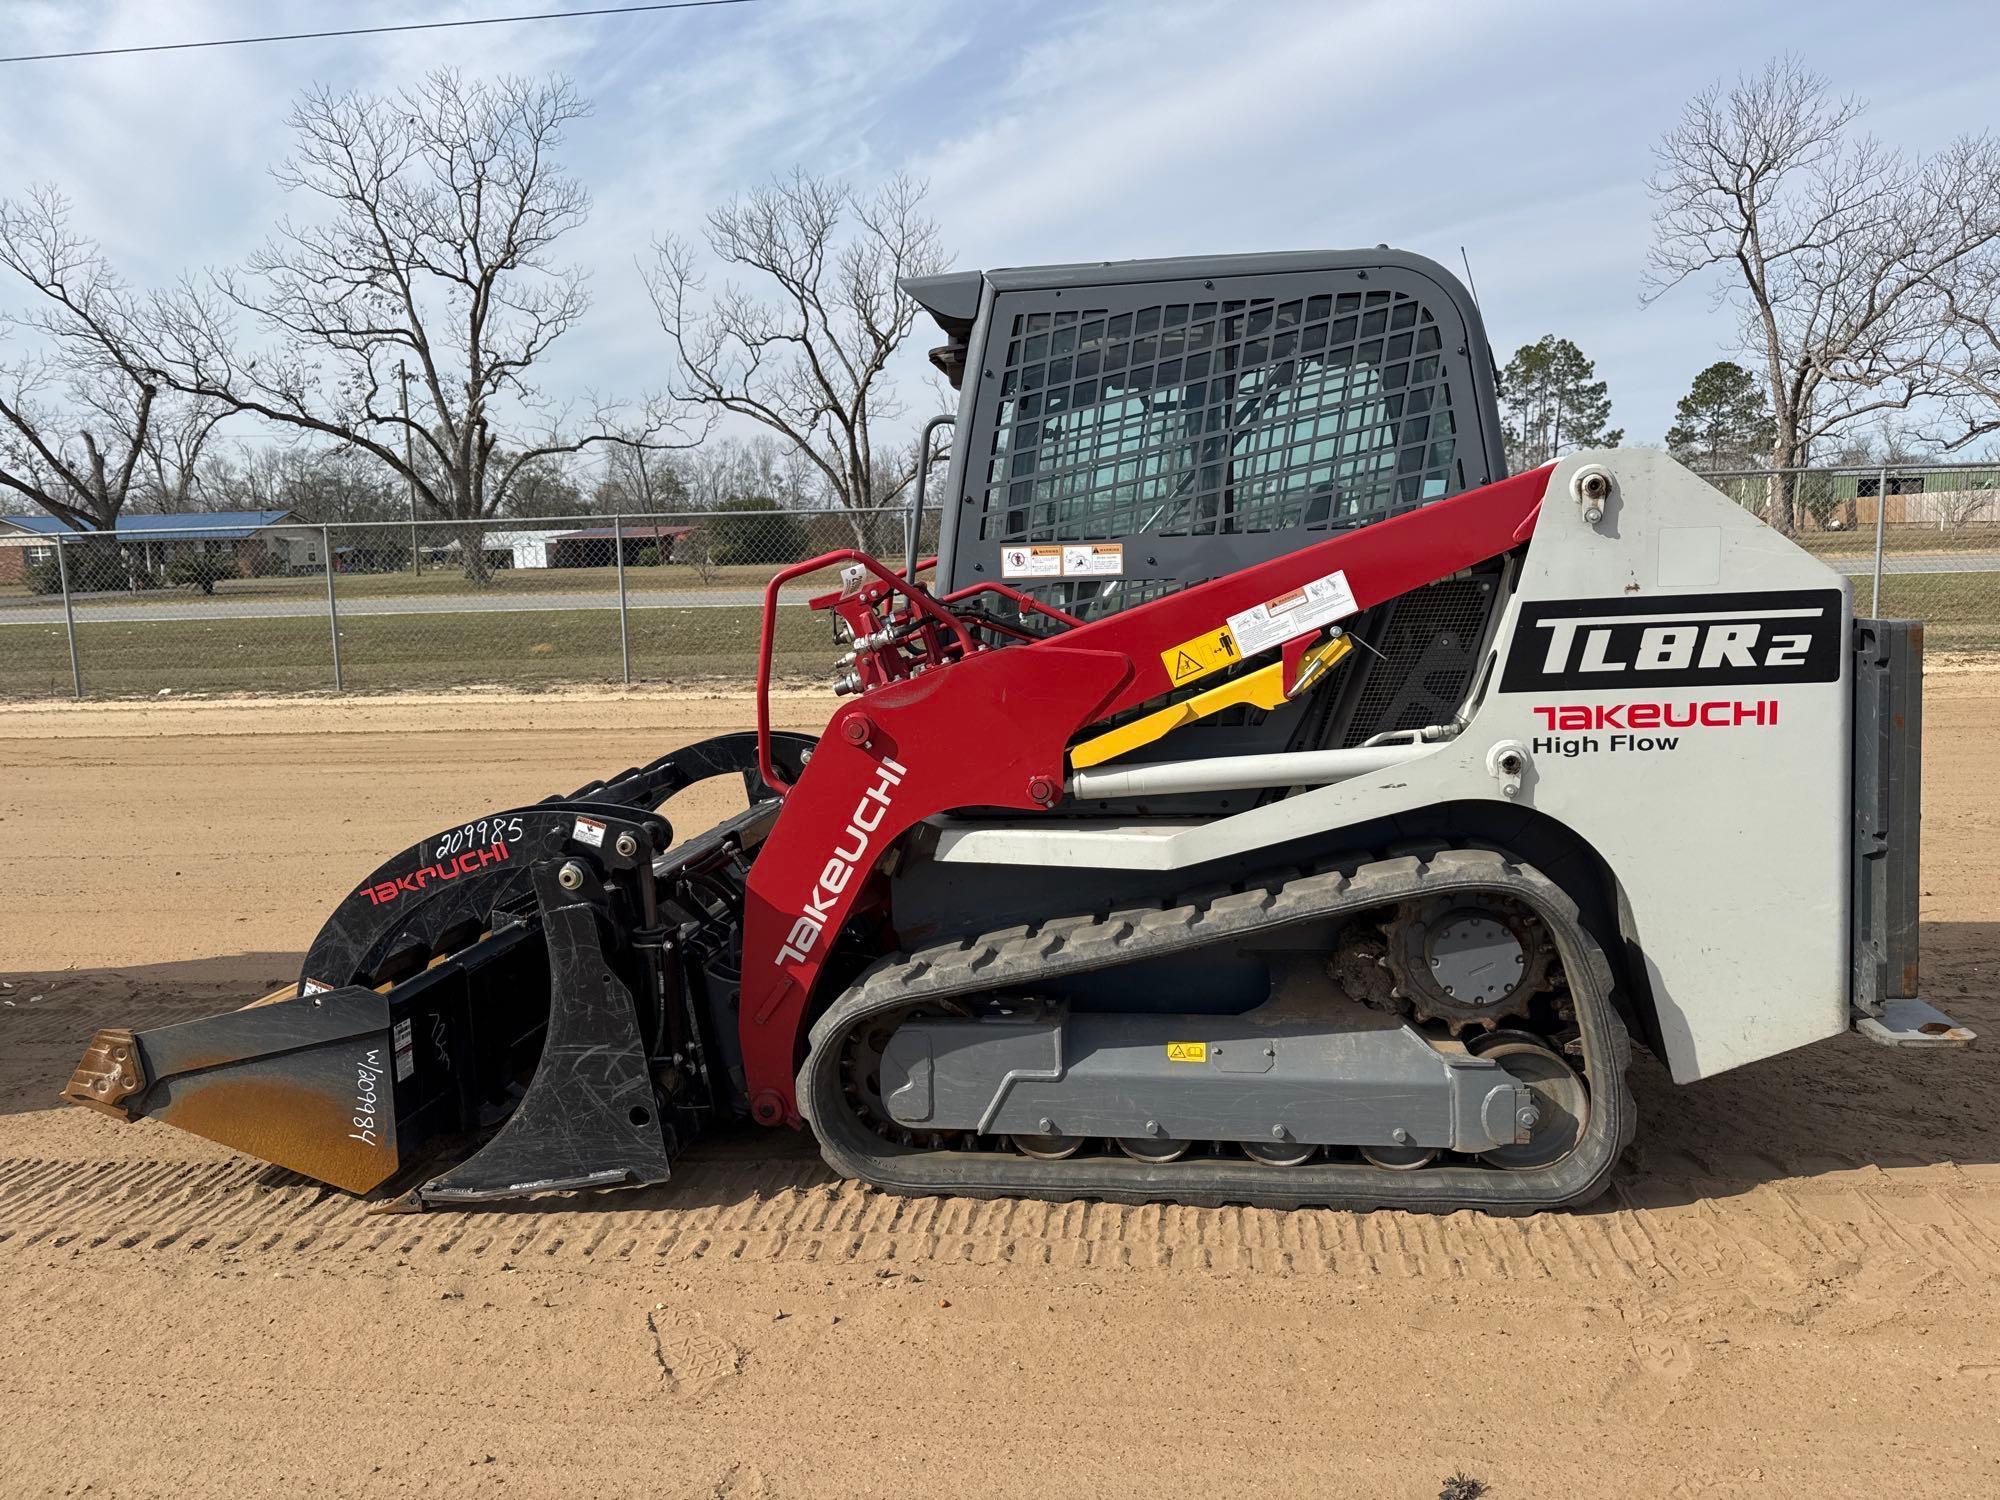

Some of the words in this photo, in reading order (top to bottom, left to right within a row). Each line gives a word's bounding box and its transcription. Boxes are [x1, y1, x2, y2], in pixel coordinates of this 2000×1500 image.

[1533, 700, 1779, 731] TAKEUCHI
[1532, 735, 1599, 757] High
[1610, 734, 1680, 752] Flow
[436, 818, 523, 859] 209985
[774, 756, 908, 966] TAKEUCHI
